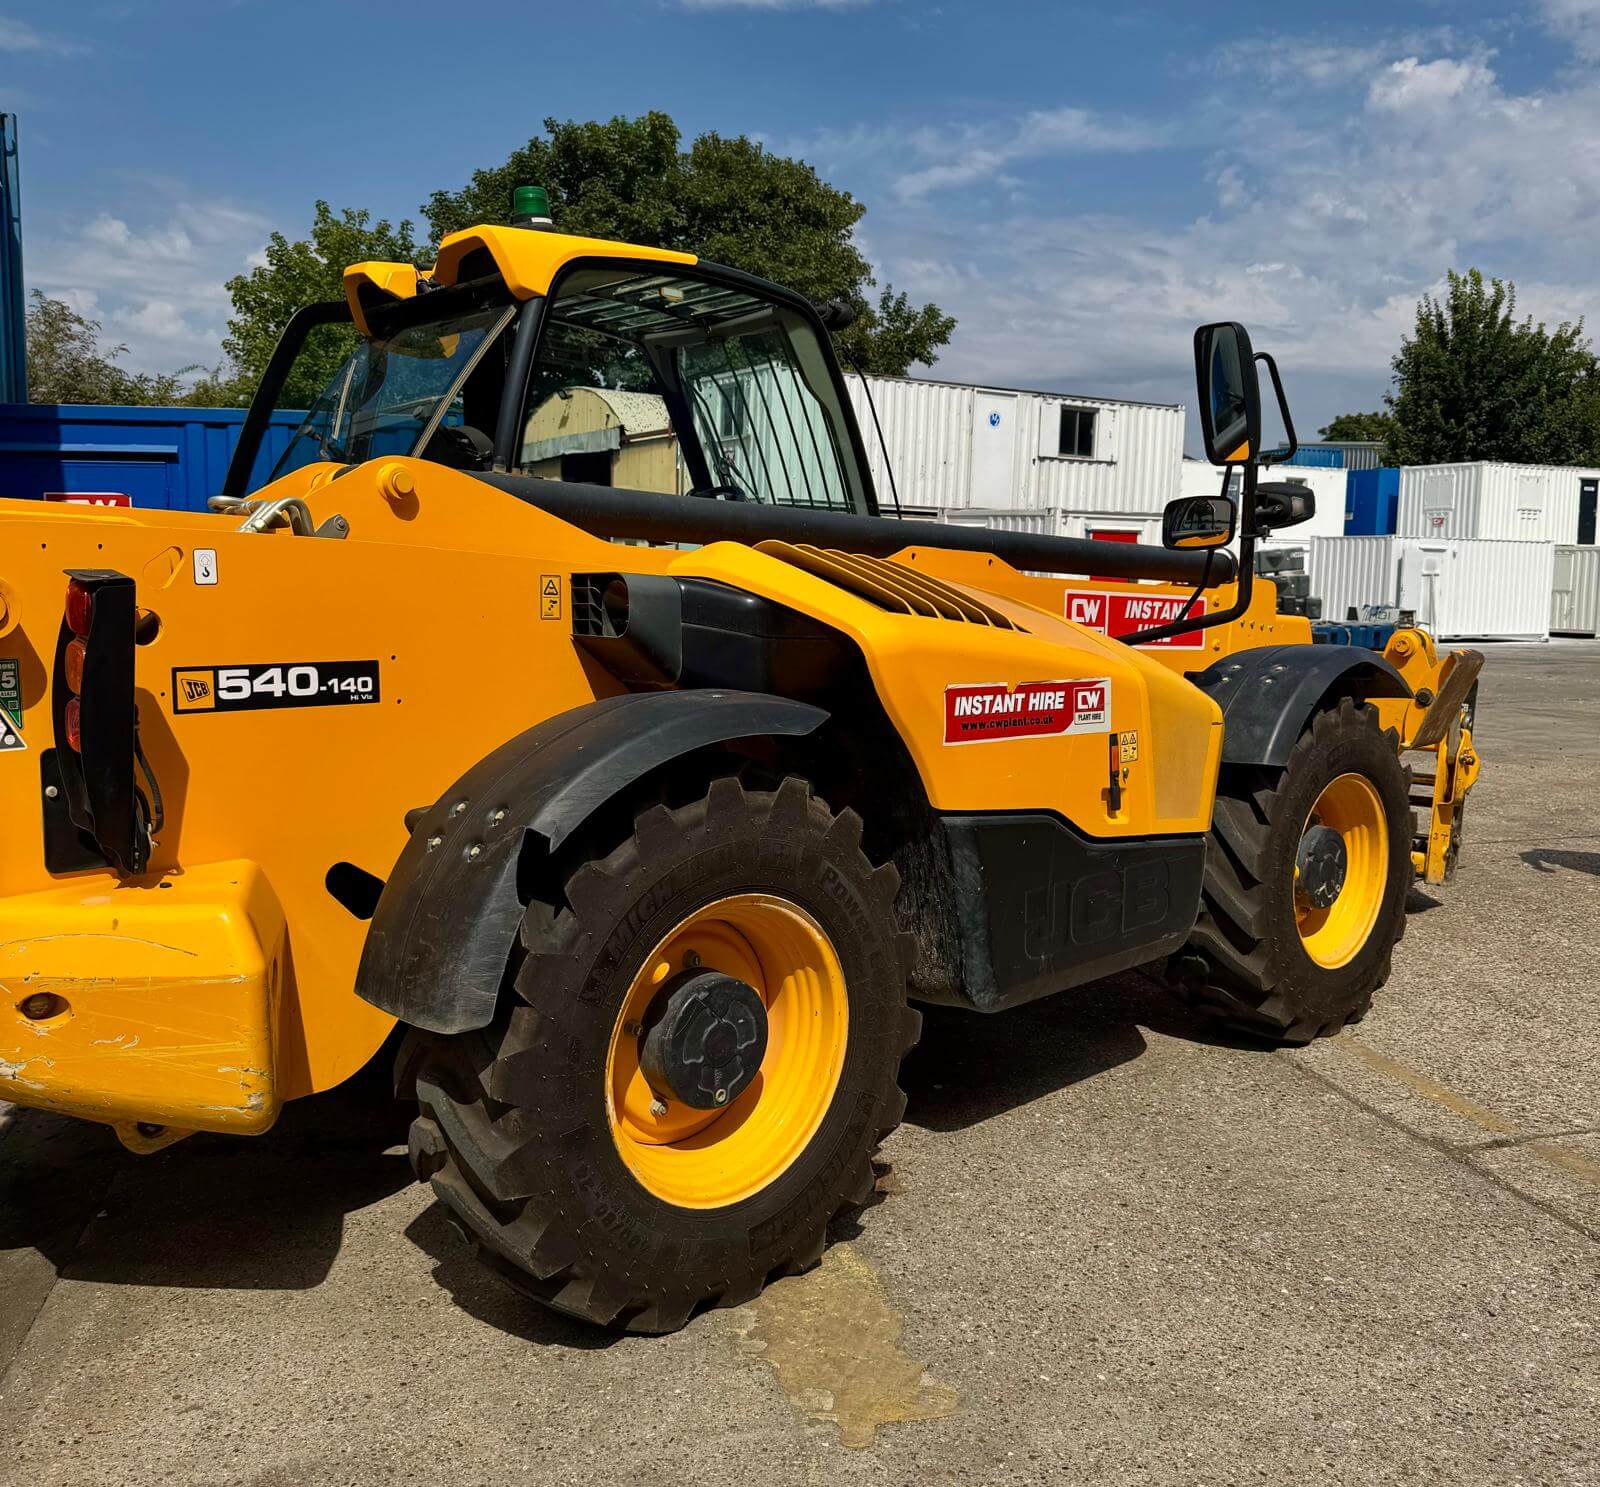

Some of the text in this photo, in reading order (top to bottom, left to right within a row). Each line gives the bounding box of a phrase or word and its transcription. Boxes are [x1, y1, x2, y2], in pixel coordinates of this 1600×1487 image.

[1071, 598, 1101, 623] CW
[186, 666, 373, 700] JCB 540-140
[954, 691, 1065, 716] INSTANT HIRE
[1077, 690, 1101, 710] CW
[961, 715, 1054, 732] www.cwplant.co.uk
[1078, 712, 1092, 721] PLANT
[1024, 859, 1170, 959] JCB
